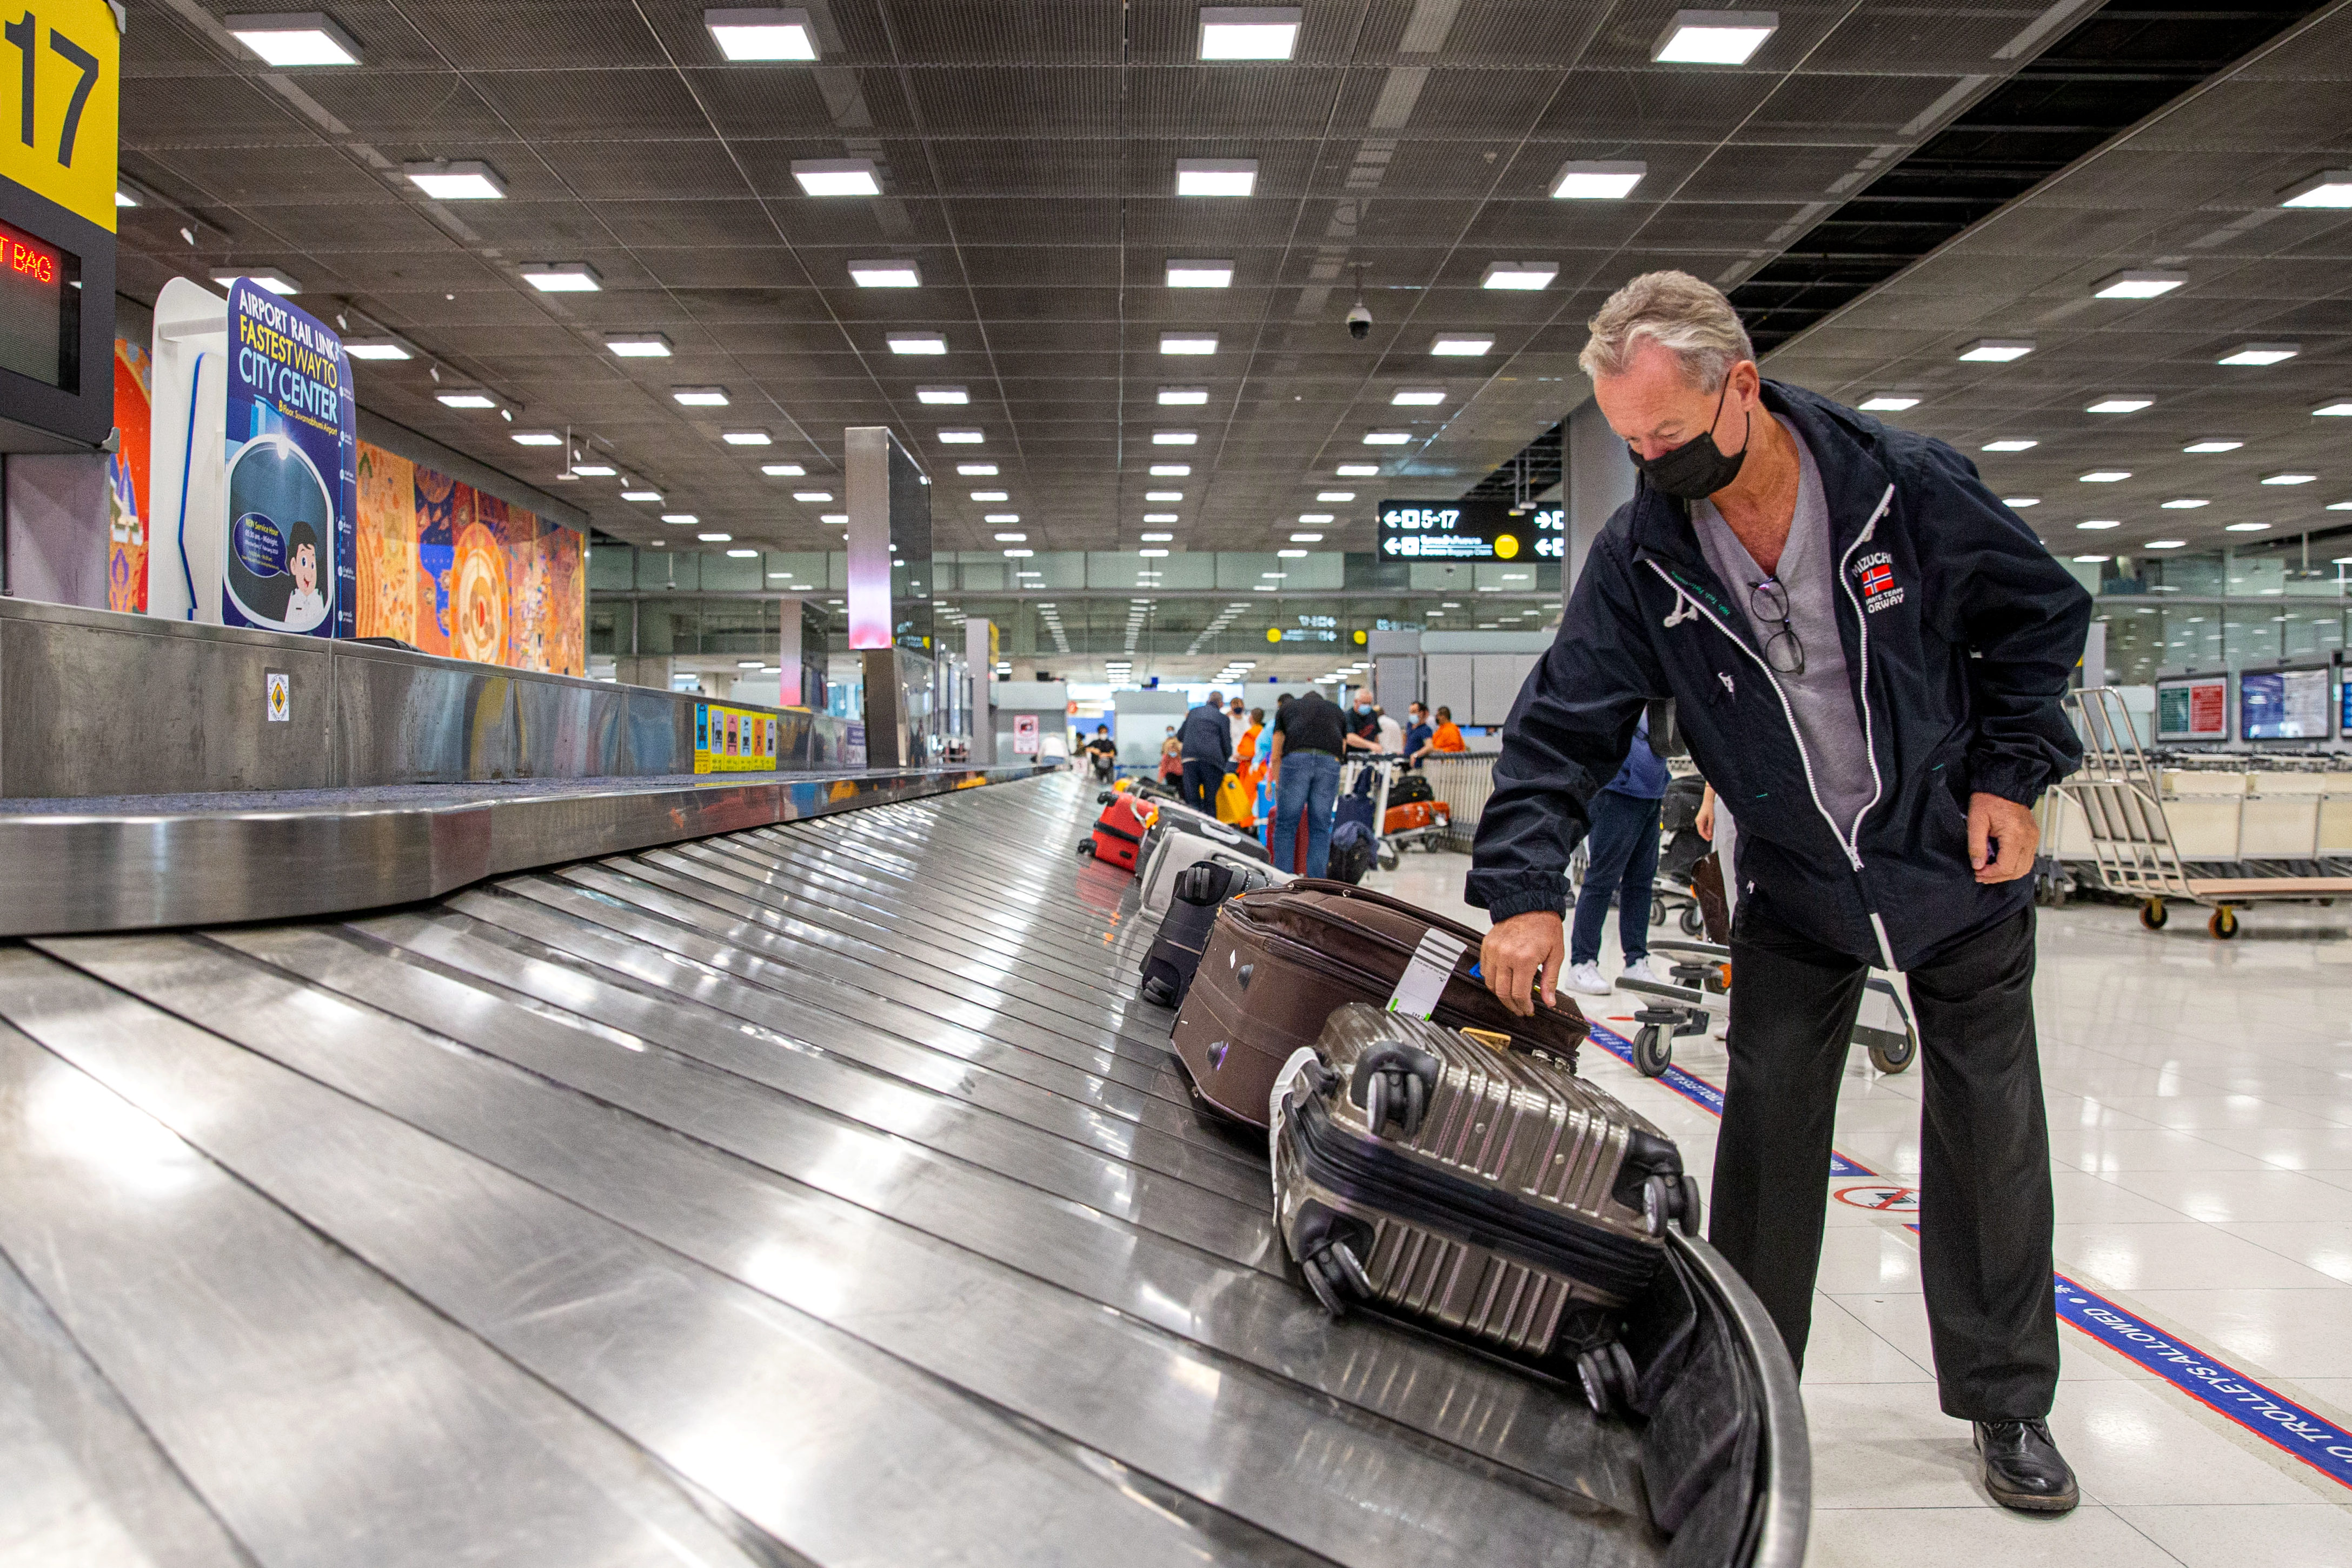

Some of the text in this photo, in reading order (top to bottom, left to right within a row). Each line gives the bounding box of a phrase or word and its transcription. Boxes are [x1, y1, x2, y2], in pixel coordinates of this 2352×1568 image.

[5, 10, 99, 169] 17
[14, 243, 52, 282] BAG
[239, 288, 336, 363] AIRPORT RAIL LINK
[240, 314, 337, 389] FASTEST WAY TO
[239, 346, 338, 424] CITY CENTER
[278, 399, 283, 413] B
[323, 423, 338, 436] Airport
[1420, 509, 1460, 529] 5-17
[1851, 552, 1892, 578] MIZUCHI
[1868, 593, 1905, 614] ORWAY
[1883, 587, 1903, 599] TEAM
[2083, 1307, 2200, 1366] ALLOWED
[2185, 1366, 2334, 1443] TROLLEYS
